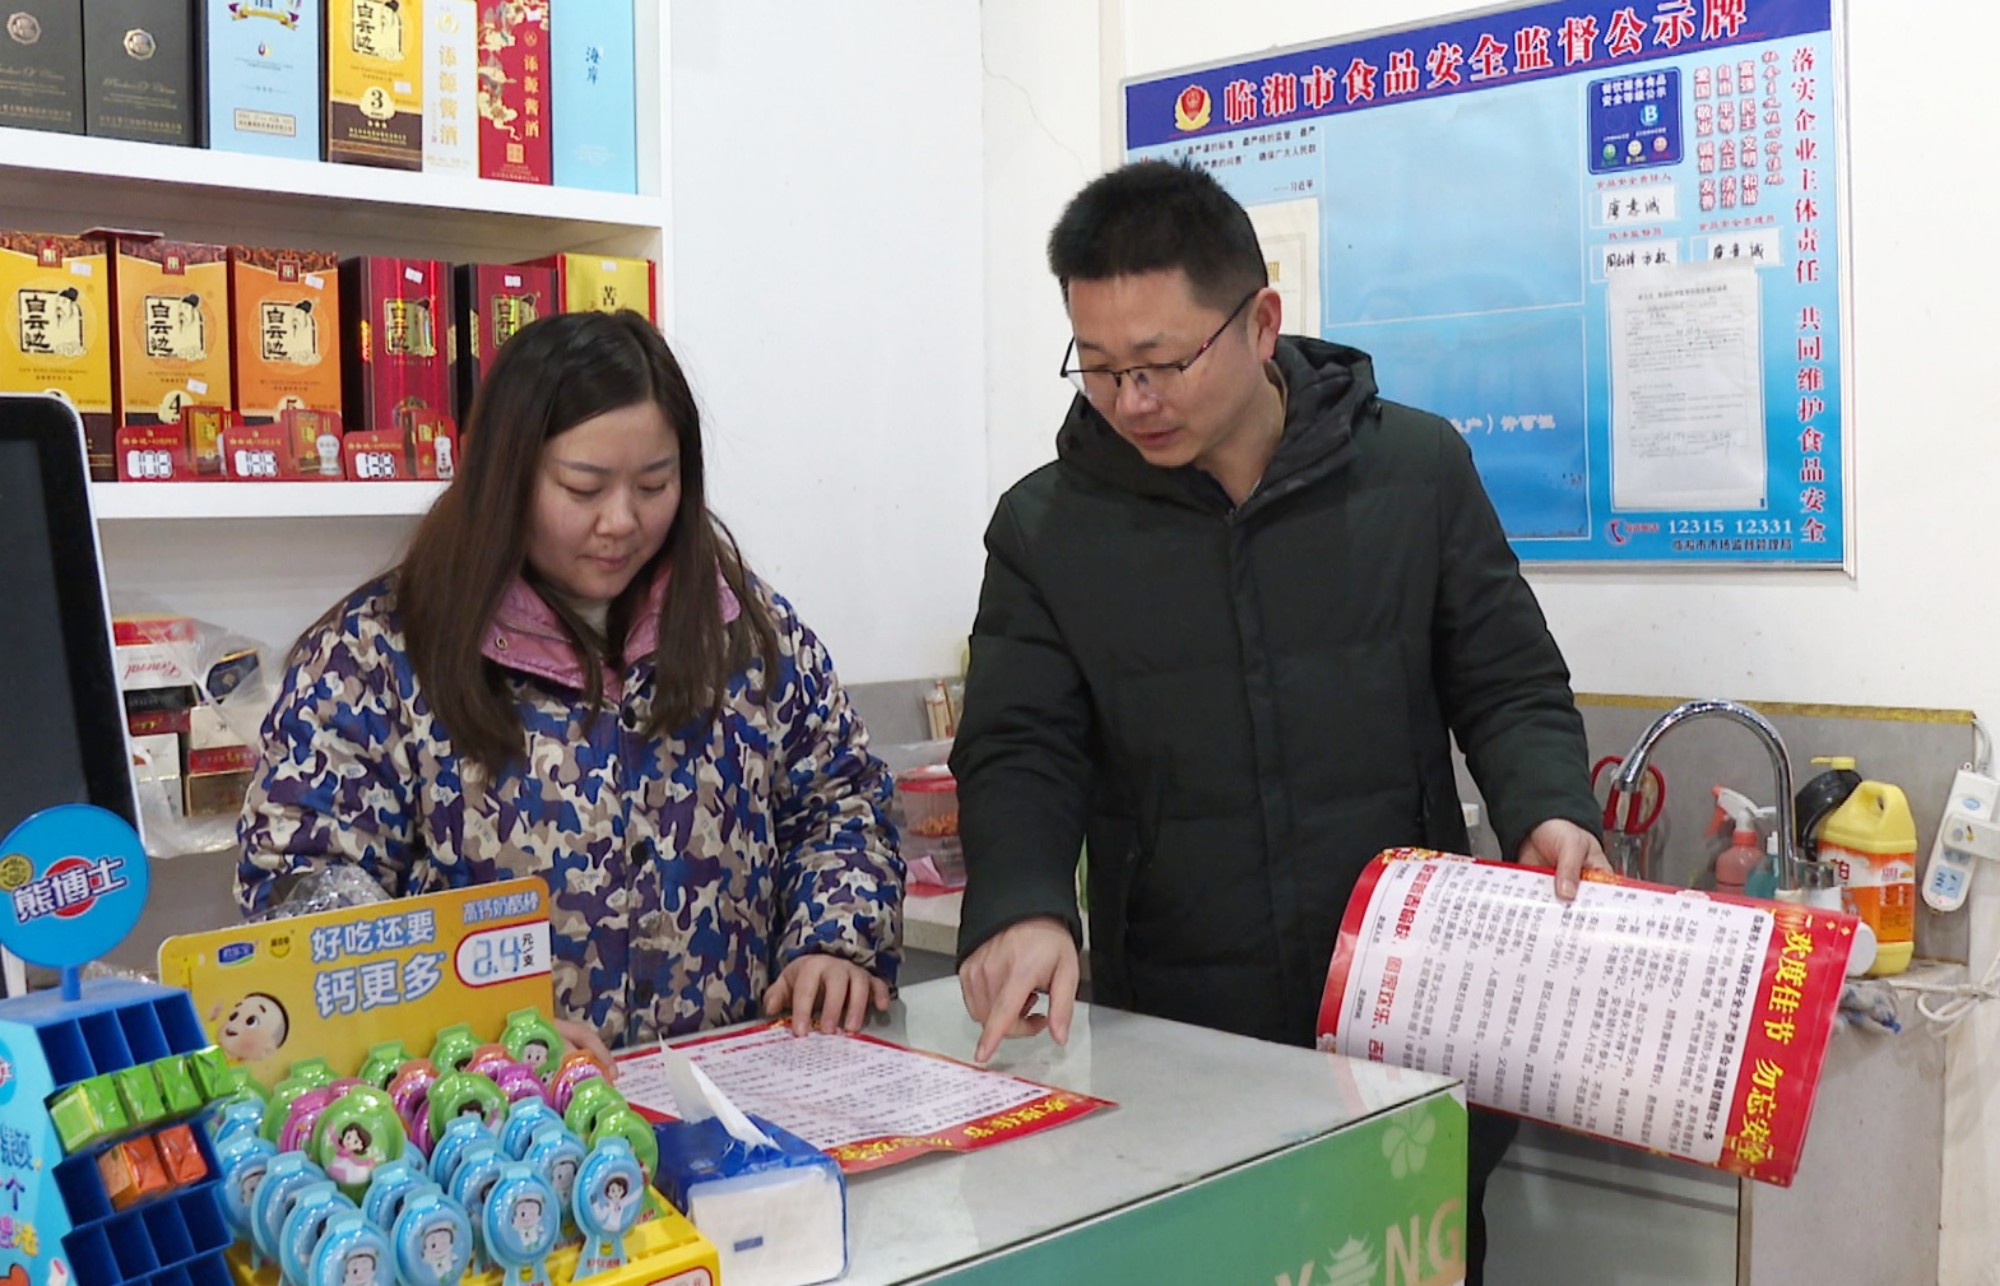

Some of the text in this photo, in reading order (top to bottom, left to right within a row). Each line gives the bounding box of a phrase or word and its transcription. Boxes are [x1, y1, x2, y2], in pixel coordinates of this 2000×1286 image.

[1223, 0, 1750, 125] 临湘市食品安全监督公示牌
[370, 89, 384, 109] 3
[1644, 105, 1658, 122] B
[1740, 98, 1756, 130] 民主
[1696, 104, 1713, 137] 敬业
[1718, 101, 1734, 134] 平等
[1698, 141, 1715, 173] 诚信
[1720, 139, 1736, 169] 公正
[1742, 135, 1758, 168] 文明
[1791, 47, 1827, 543] 落实企业主体责任 共同维护食品安全
[24, 295, 50, 351] 白云边
[149, 301, 174, 354] 白云边
[266, 307, 288, 358] 白云边
[169, 394, 182, 415] 4
[1668, 518, 1794, 535] 12315 12331
[12, 857, 127, 923] 熊博士
[310, 907, 437, 964] 好吃还要
[312, 951, 443, 1020] 钙更多
[1736, 927, 1814, 1166] 欢度佳节 勿忘安全
